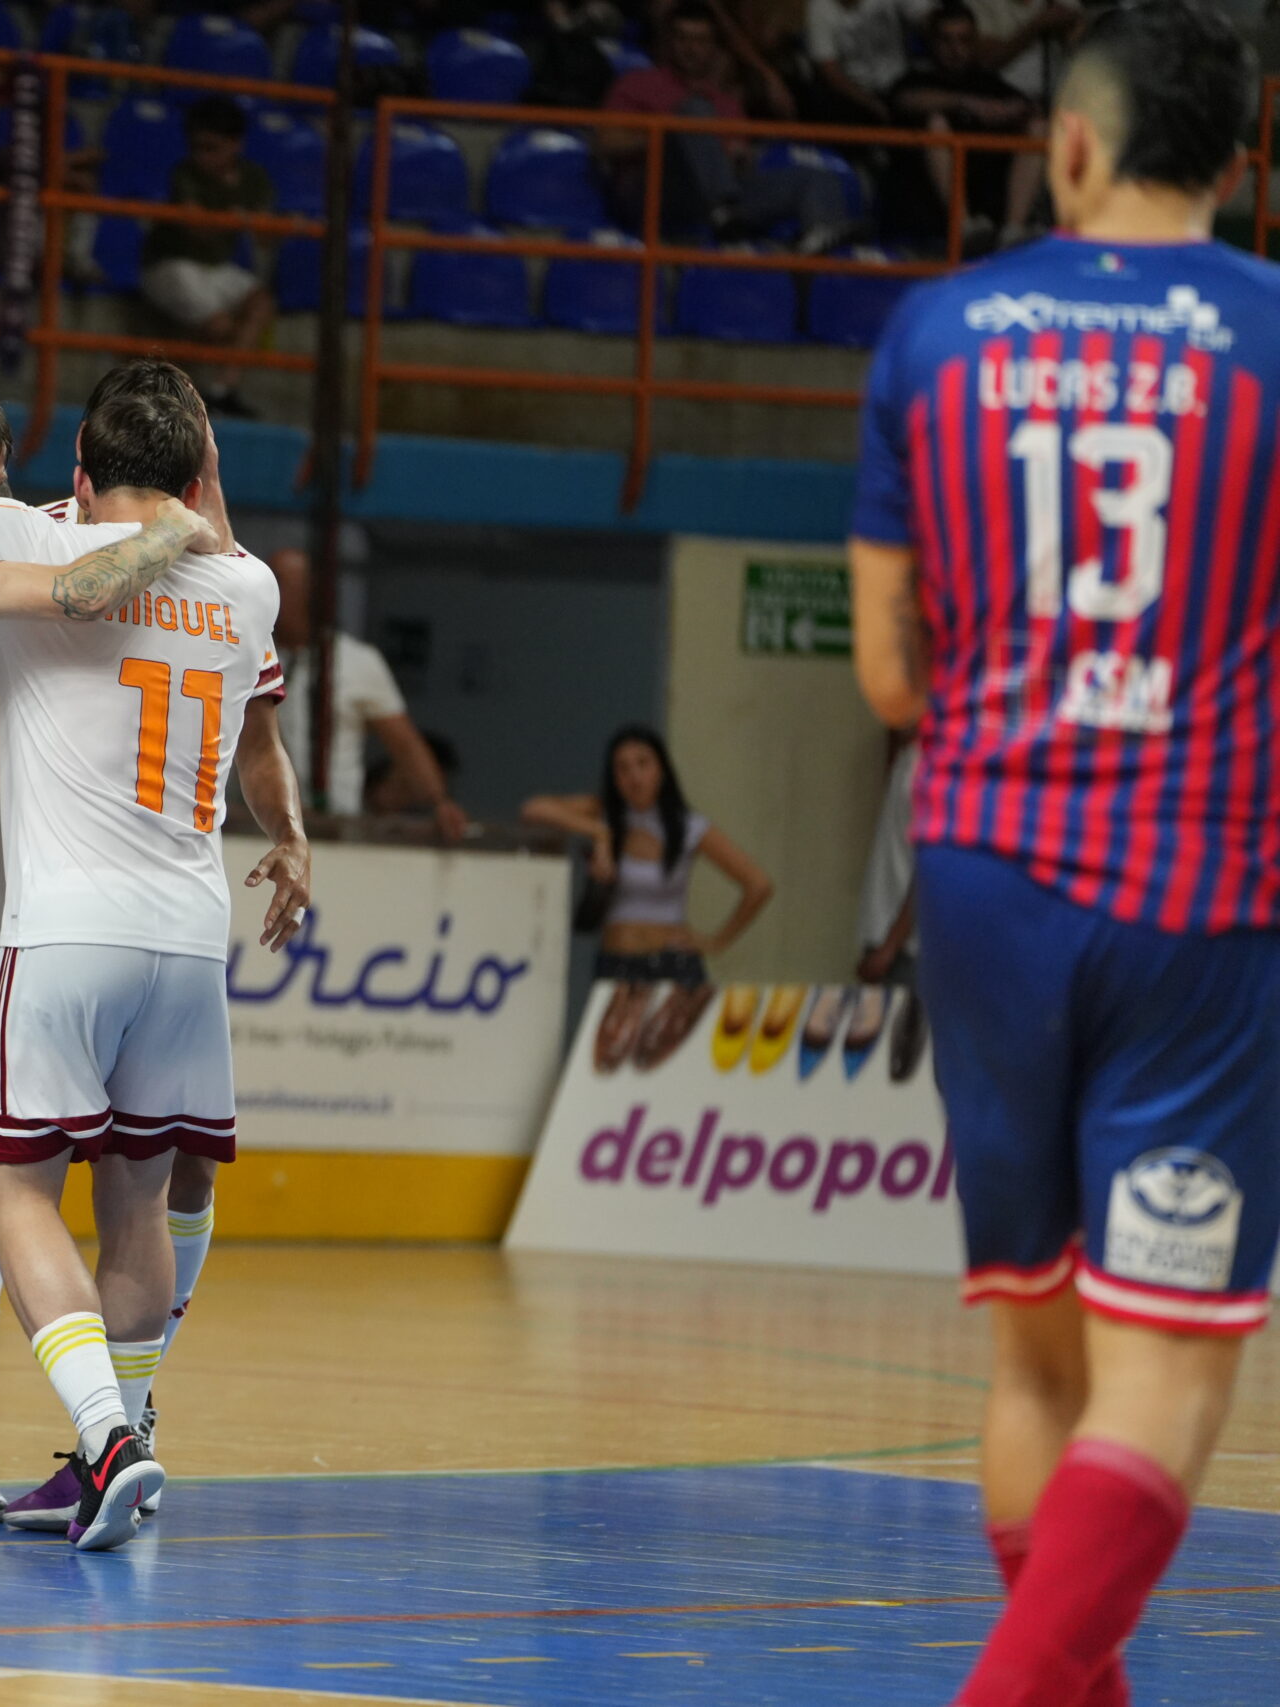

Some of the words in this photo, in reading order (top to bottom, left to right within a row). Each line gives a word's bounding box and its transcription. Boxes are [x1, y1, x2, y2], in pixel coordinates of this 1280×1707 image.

[978, 358, 1119, 412] LUCAS
[1008, 420, 1173, 622] 13
[119, 657, 223, 833] 11
